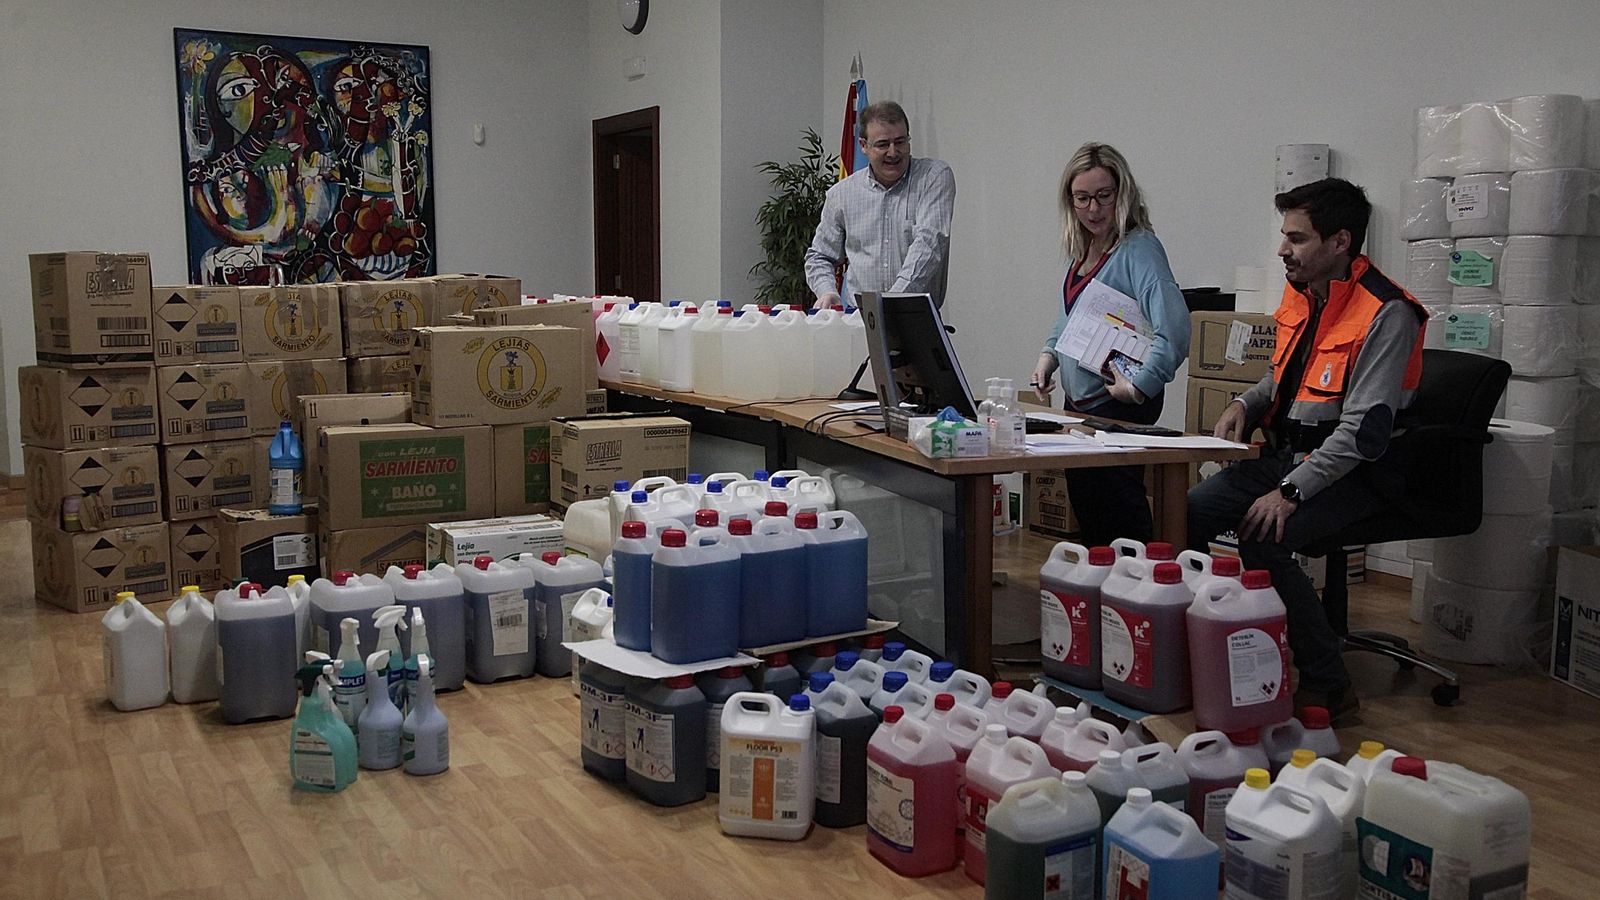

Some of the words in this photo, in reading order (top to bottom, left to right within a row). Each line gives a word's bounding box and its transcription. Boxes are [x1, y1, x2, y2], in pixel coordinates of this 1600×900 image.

[272, 335, 316, 351] SARMIENTO
[492, 338, 531, 352] LEJIAS
[486, 388, 538, 408] SARMIENTO
[585, 439, 622, 461] ESTRELLA
[365, 456, 457, 478] SARMIENTO
[391, 482, 437, 499] BAÑO
